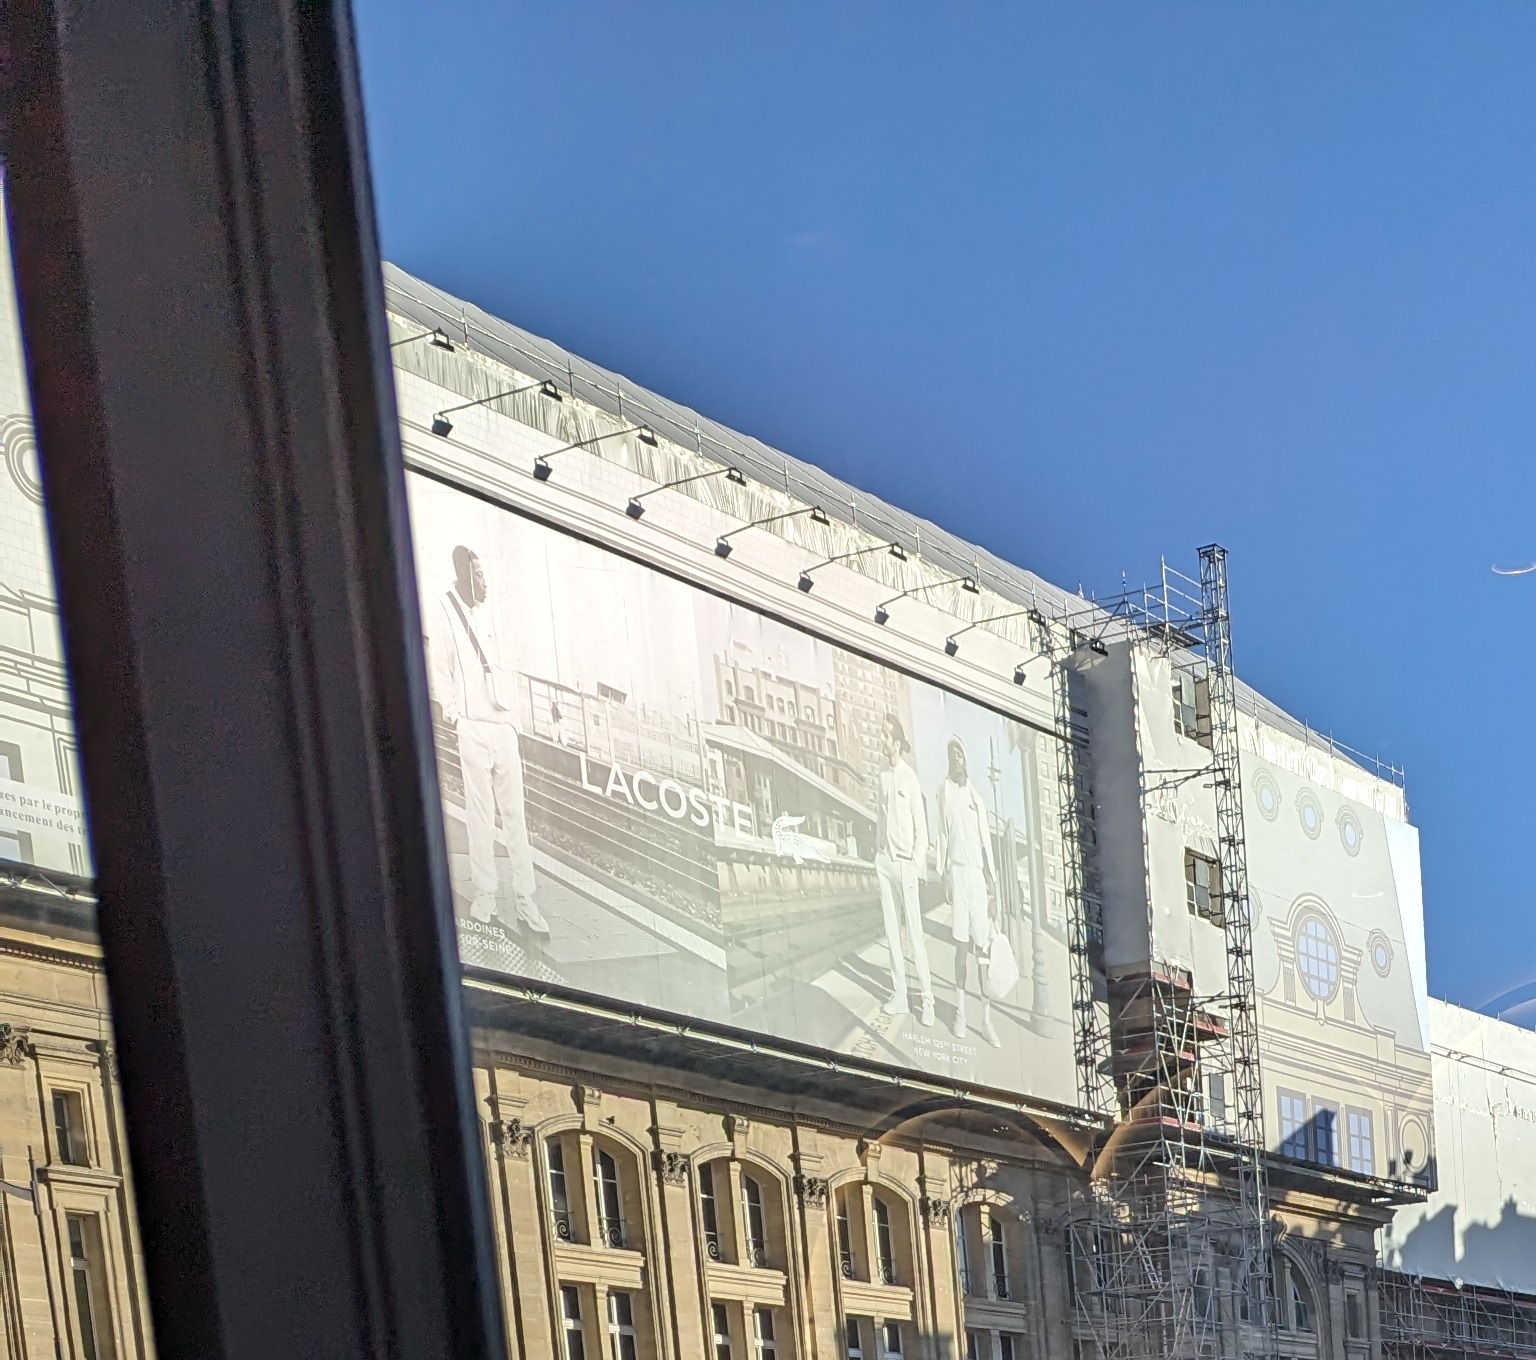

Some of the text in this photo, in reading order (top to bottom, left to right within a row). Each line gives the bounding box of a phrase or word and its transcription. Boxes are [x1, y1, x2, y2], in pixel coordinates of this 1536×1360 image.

[19, 796, 39, 808] par
[42, 799, 52, 811] le
[579, 752, 755, 842] LACOSTE
[56, 819, 74, 833] des
[459, 934, 513, 954] SUR-SEINE
[902, 1032, 931, 1046] HARLEM
[952, 1043, 977, 1056] STREET
[913, 1047, 968, 1067] NEW YORK CITY
